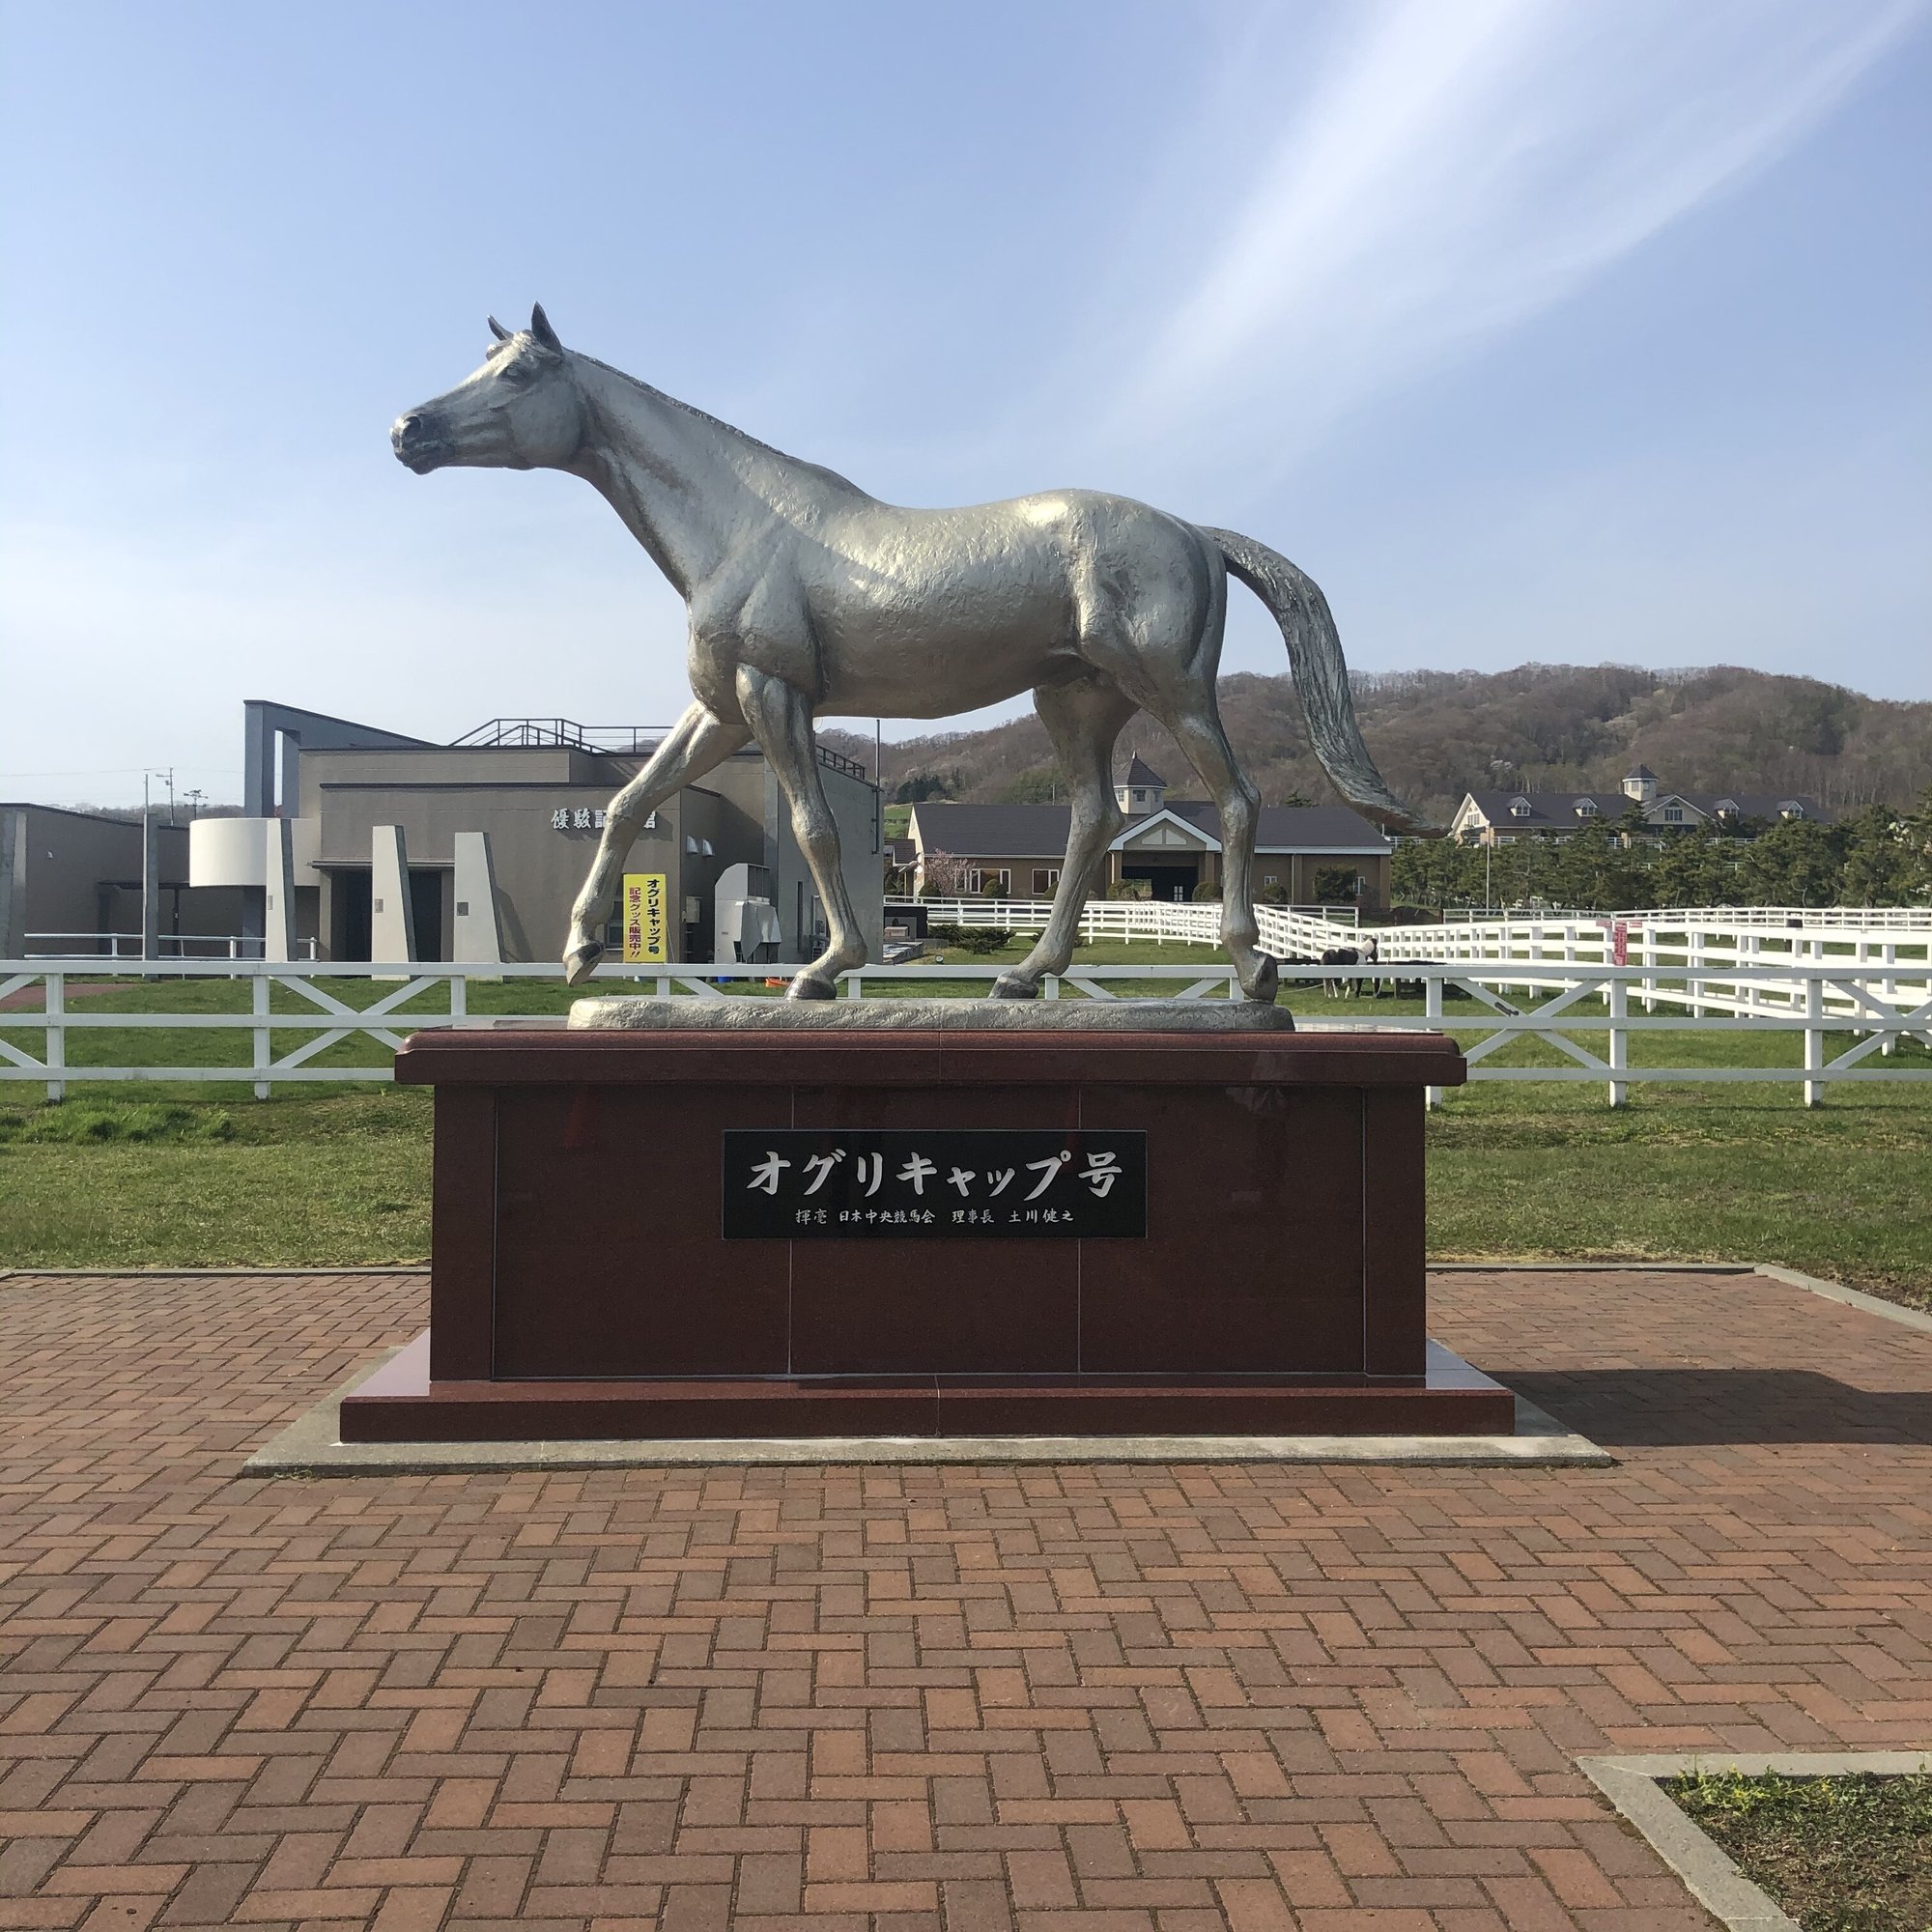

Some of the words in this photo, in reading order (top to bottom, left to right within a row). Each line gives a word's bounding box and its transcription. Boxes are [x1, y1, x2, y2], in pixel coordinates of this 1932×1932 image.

[646, 878, 661, 954] オグリキャップ号
[747, 1149, 1122, 1201] オグリキャップ号
[838, 1208, 936, 1225] 日本中央競馬会
[952, 1208, 995, 1224] 理事長
[1009, 1208, 1074, 1224] 土川健之
